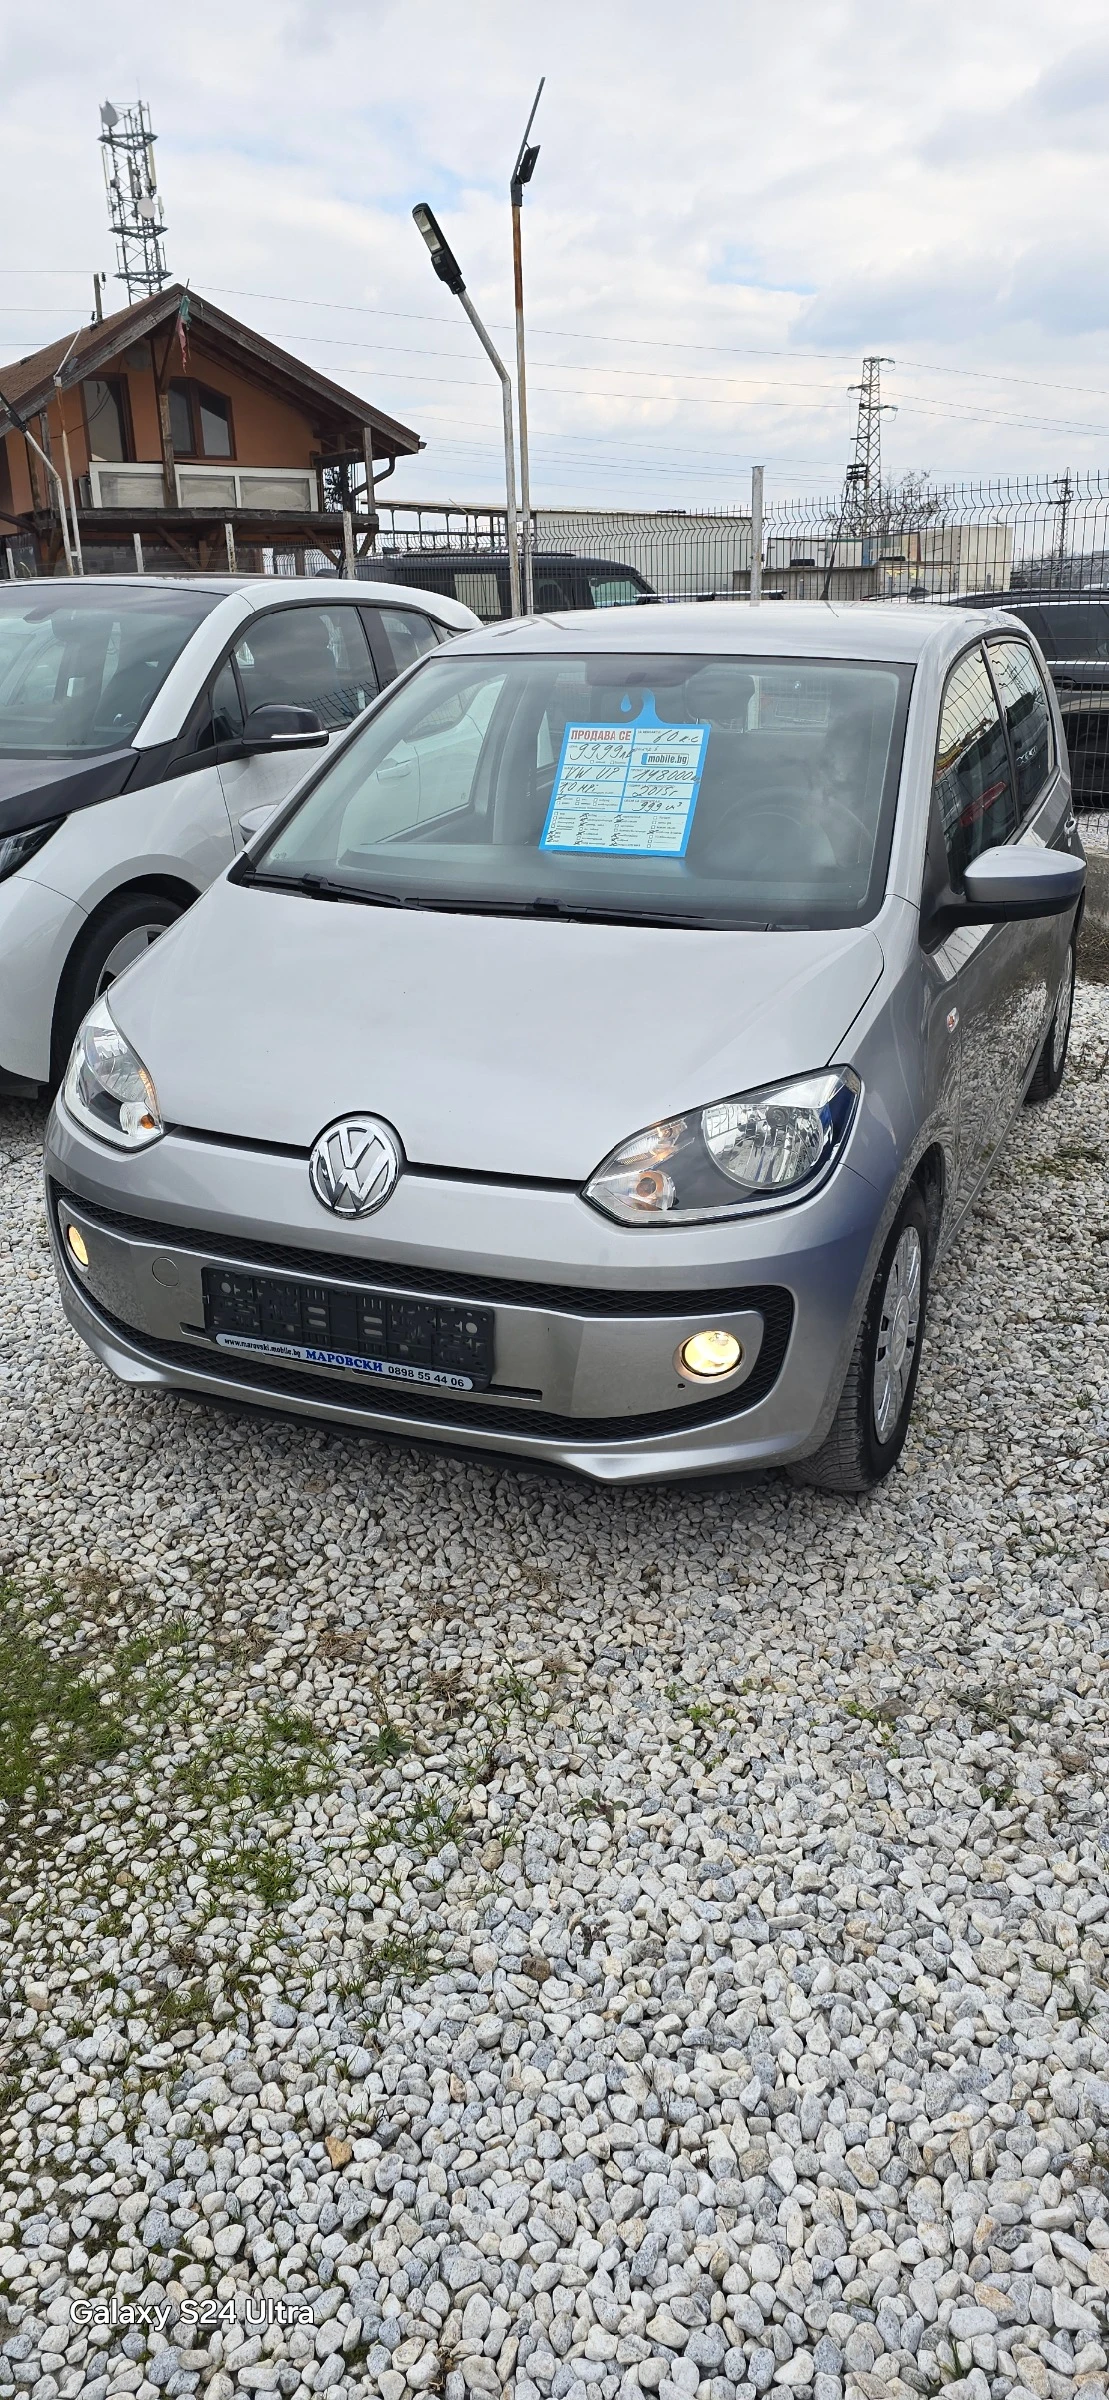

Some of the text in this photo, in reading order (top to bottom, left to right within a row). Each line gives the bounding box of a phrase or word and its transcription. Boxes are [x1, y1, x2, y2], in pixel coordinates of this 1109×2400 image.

[571, 730, 632, 741] ПРОДАВА СЕ
[648, 754, 688, 764] mobile.bg
[565, 766, 592, 780] VW
[632, 801, 663, 812] 999
[311, 1116, 398, 1216] VW
[224, 1339, 301, 1358] www.marovski.mobile.bg
[305, 1350, 383, 1372] МАРОВСКИ
[388, 1366, 465, 1387] 0898 55 44 06
